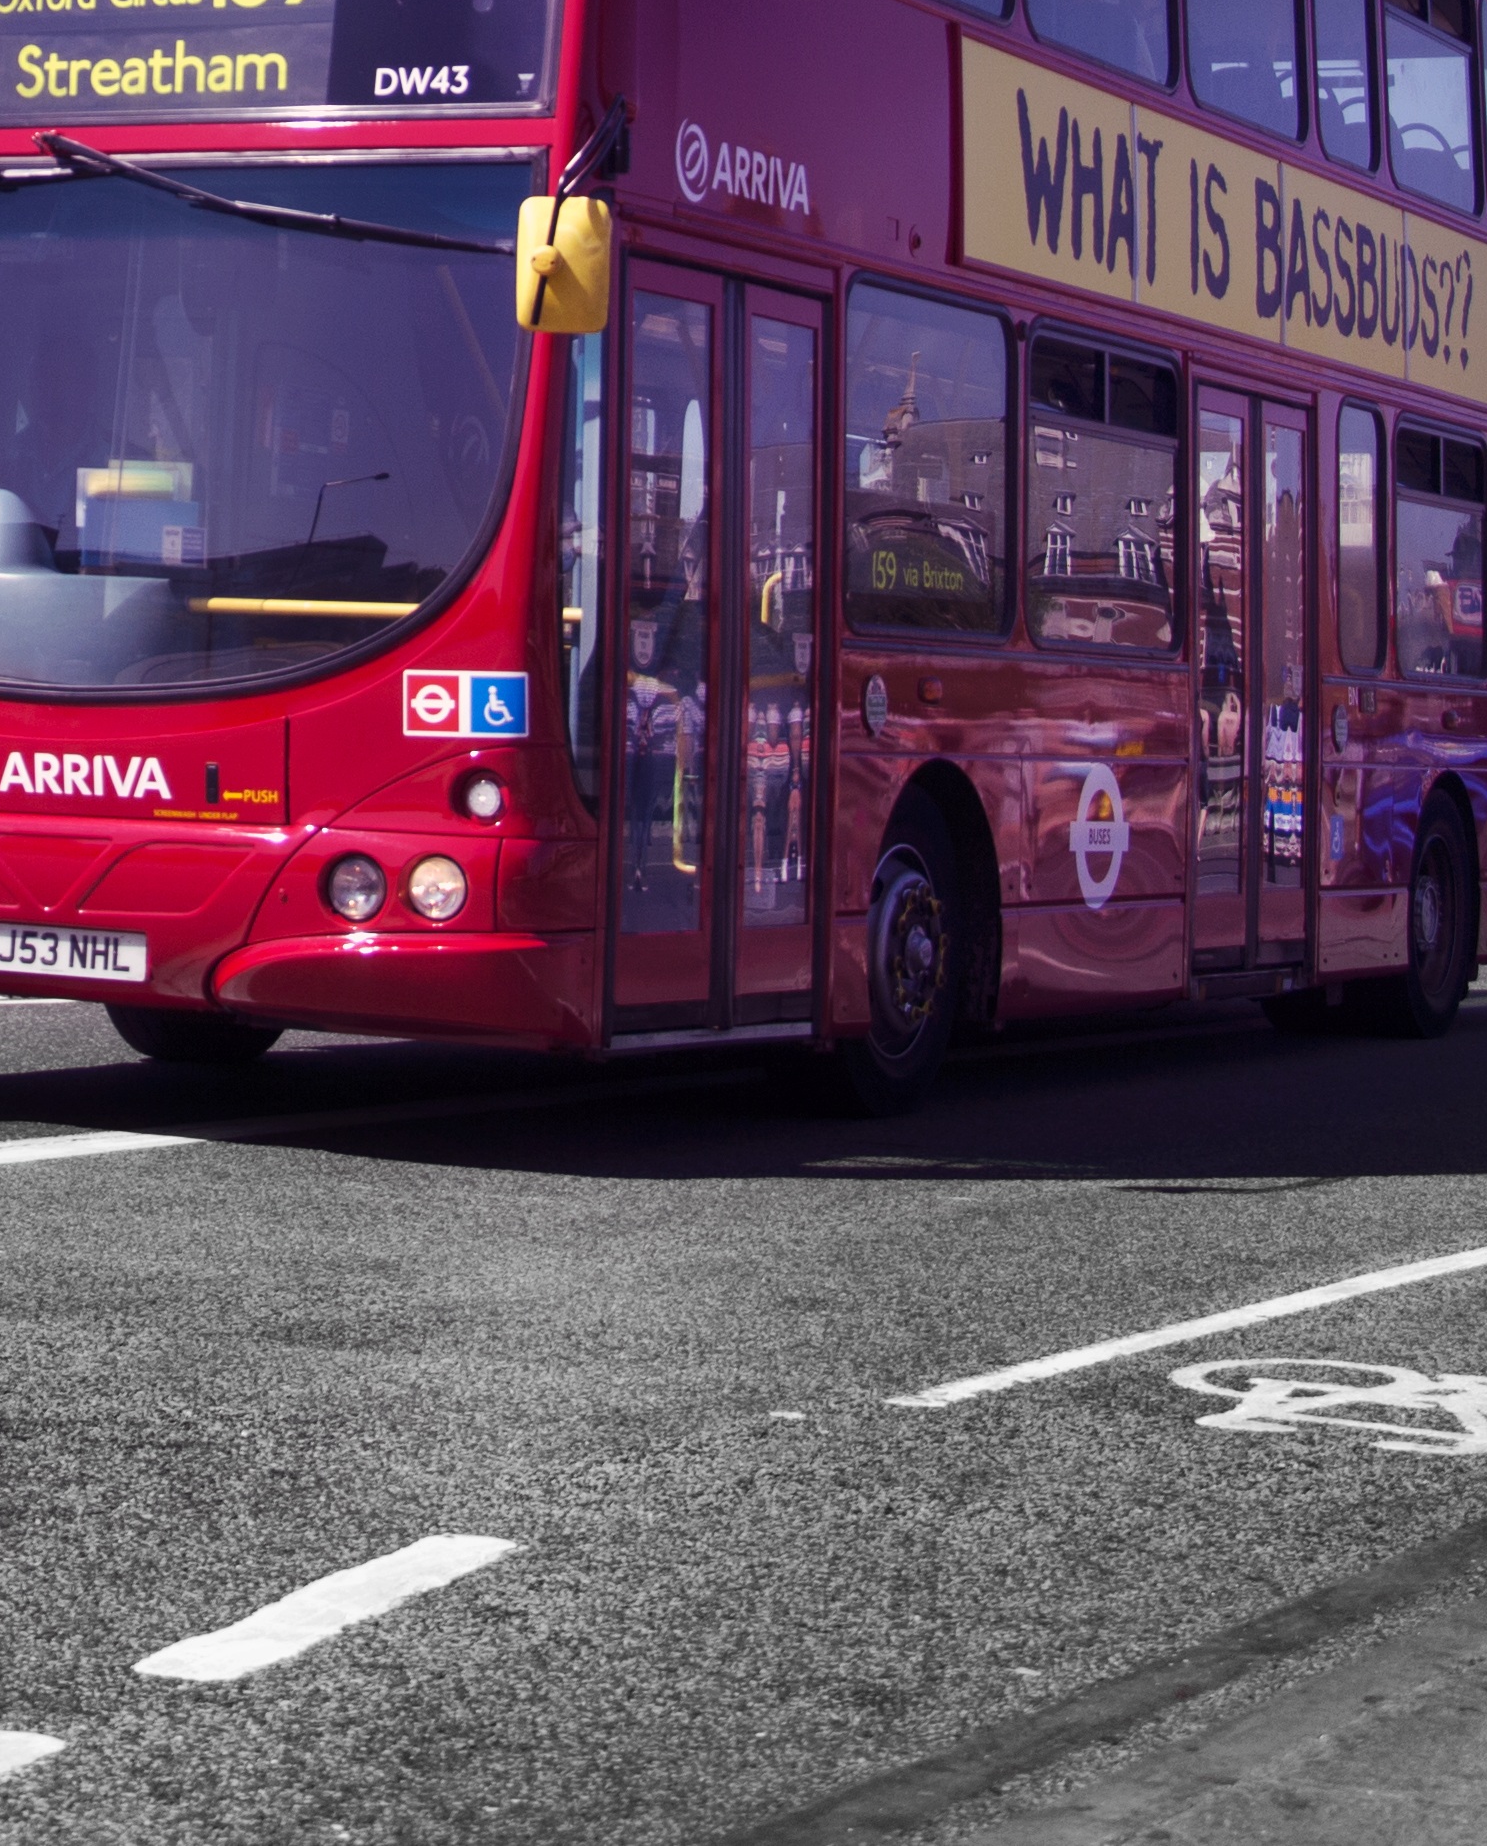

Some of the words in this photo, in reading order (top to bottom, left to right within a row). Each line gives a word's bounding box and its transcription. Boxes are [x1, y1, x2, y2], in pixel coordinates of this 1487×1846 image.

[16, 40, 288, 98] Streatham
[374, 65, 470, 96] DW43
[712, 142, 810, 215] ARRIVA
[1016, 87, 1164, 287] WHAT
[1190, 157, 1230, 300] IS
[1255, 177, 1473, 371] BASSBUDS??
[872, 551, 896, 589] 159
[903, 563, 919, 587] via
[923, 561, 964, 591] Brixton
[243, 789, 279, 803] PUSH
[1088, 828, 1111, 845] BUSES
[69, 934, 130, 972] NHL
